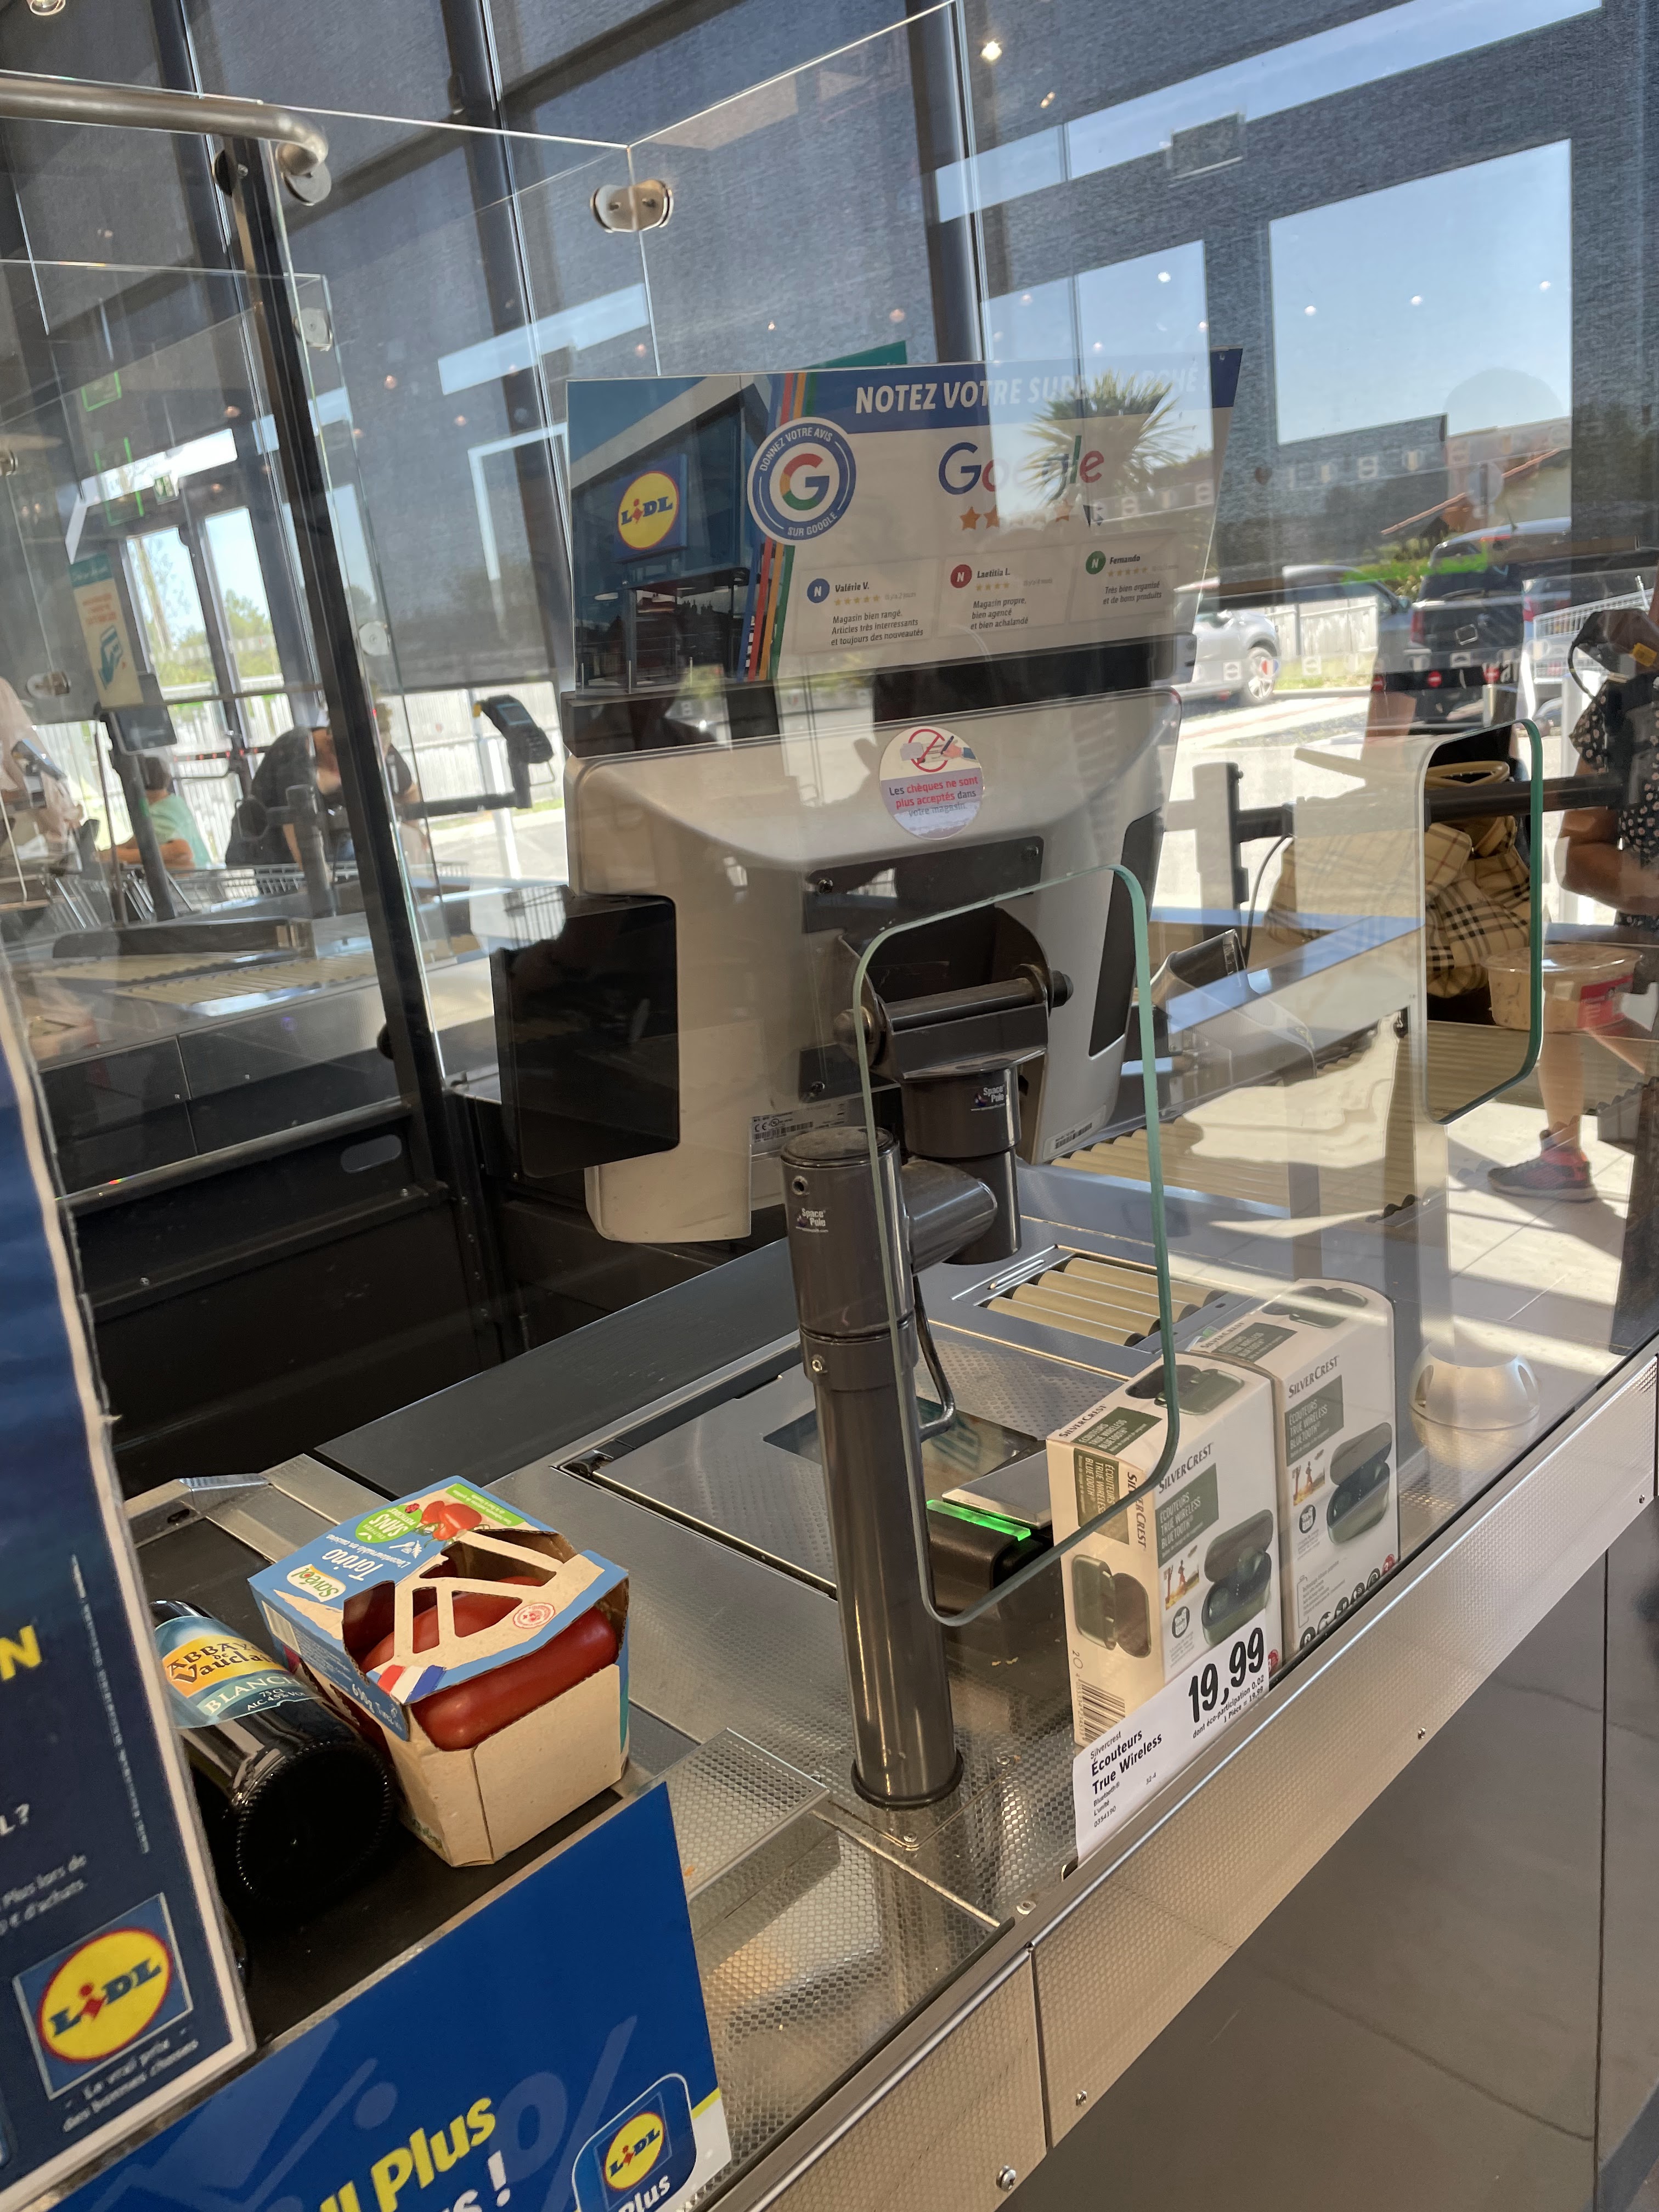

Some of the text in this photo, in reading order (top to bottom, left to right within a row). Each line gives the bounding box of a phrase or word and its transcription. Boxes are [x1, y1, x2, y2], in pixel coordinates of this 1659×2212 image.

[856, 383, 938, 414] NOTEZ
[944, 378, 1021, 409] VOTRE
[759, 427, 833, 471] DONNEZ VOTRE AVIS
[788, 512, 838, 536] SUR GOOGLE
[1110, 555, 1141, 565] Fernando
[957, 572, 964, 583] N
[977, 568, 1003, 578] Laetitia
[814, 582, 870, 597] N Valérie V.
[1119, 585, 1132, 593] bien
[1120, 594, 1135, 603] bons
[1136, 591, 1162, 602] produits
[972, 608, 1012, 619] bien agencé
[973, 599, 1001, 609] Magasin
[832, 627, 858, 635] Articles
[874, 619, 918, 630] interressants
[833, 614, 862, 624] Magasin
[864, 612, 879, 621] bien
[995, 617, 1029, 627] achalandé
[840, 635, 868, 645] toujours
[870, 633, 882, 641] des
[884, 628, 923, 639] nouveautés
[889, 776, 979, 796] Les chèques ne sont
[896, 790, 977, 810] plus acceptés dans
[909, 806, 930, 817] votre
[1095, 1462, 1104, 1480] TRUE
[369, 1513, 409, 1537] SANS
[1161, 1519, 1175, 1536] TRUE
[322, 1549, 383, 1581] Torino
[291, 1567, 339, 1597] Savéol
[172, 1650, 273, 1683] Vauclai
[1189, 1628, 1264, 1723] 19,99
[204, 1676, 301, 1714] BLANCH
[1193, 1723, 1205, 1739] dont
[1206, 1686, 1250, 1726] éco-participation
[1228, 1703, 1242, 1718] Pièce
[1091, 1731, 1121, 1759] Silvercrest
[1092, 1730, 1142, 1777] Écouteurs
[1092, 1734, 1162, 1795] True Wireless
[371, 2097, 496, 2212] Plus
